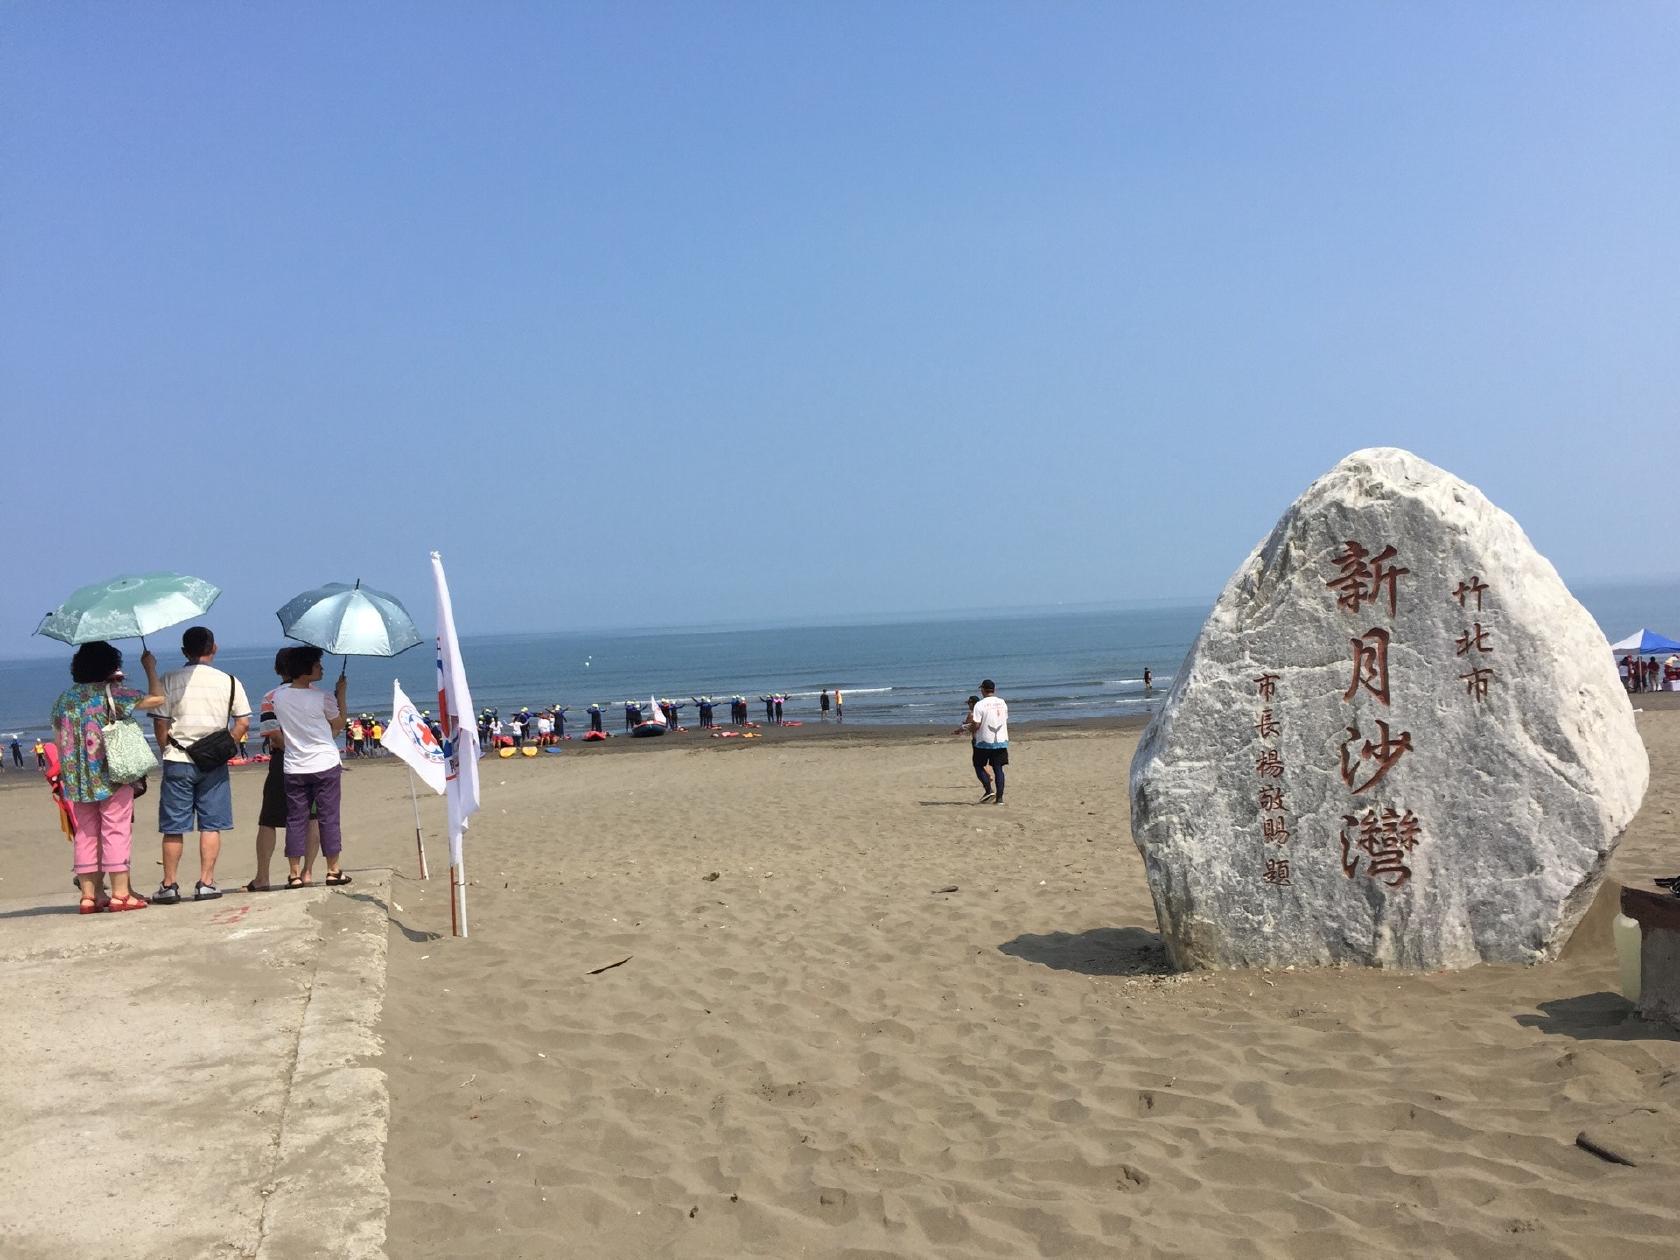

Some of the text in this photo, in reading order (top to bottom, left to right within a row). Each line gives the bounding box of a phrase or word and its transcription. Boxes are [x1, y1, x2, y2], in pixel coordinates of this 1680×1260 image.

[1326, 540, 1422, 888] 新月沙灣
[1452, 576, 1494, 703] 竹北市
[1253, 673, 1294, 887] 市長楊敬賜題
